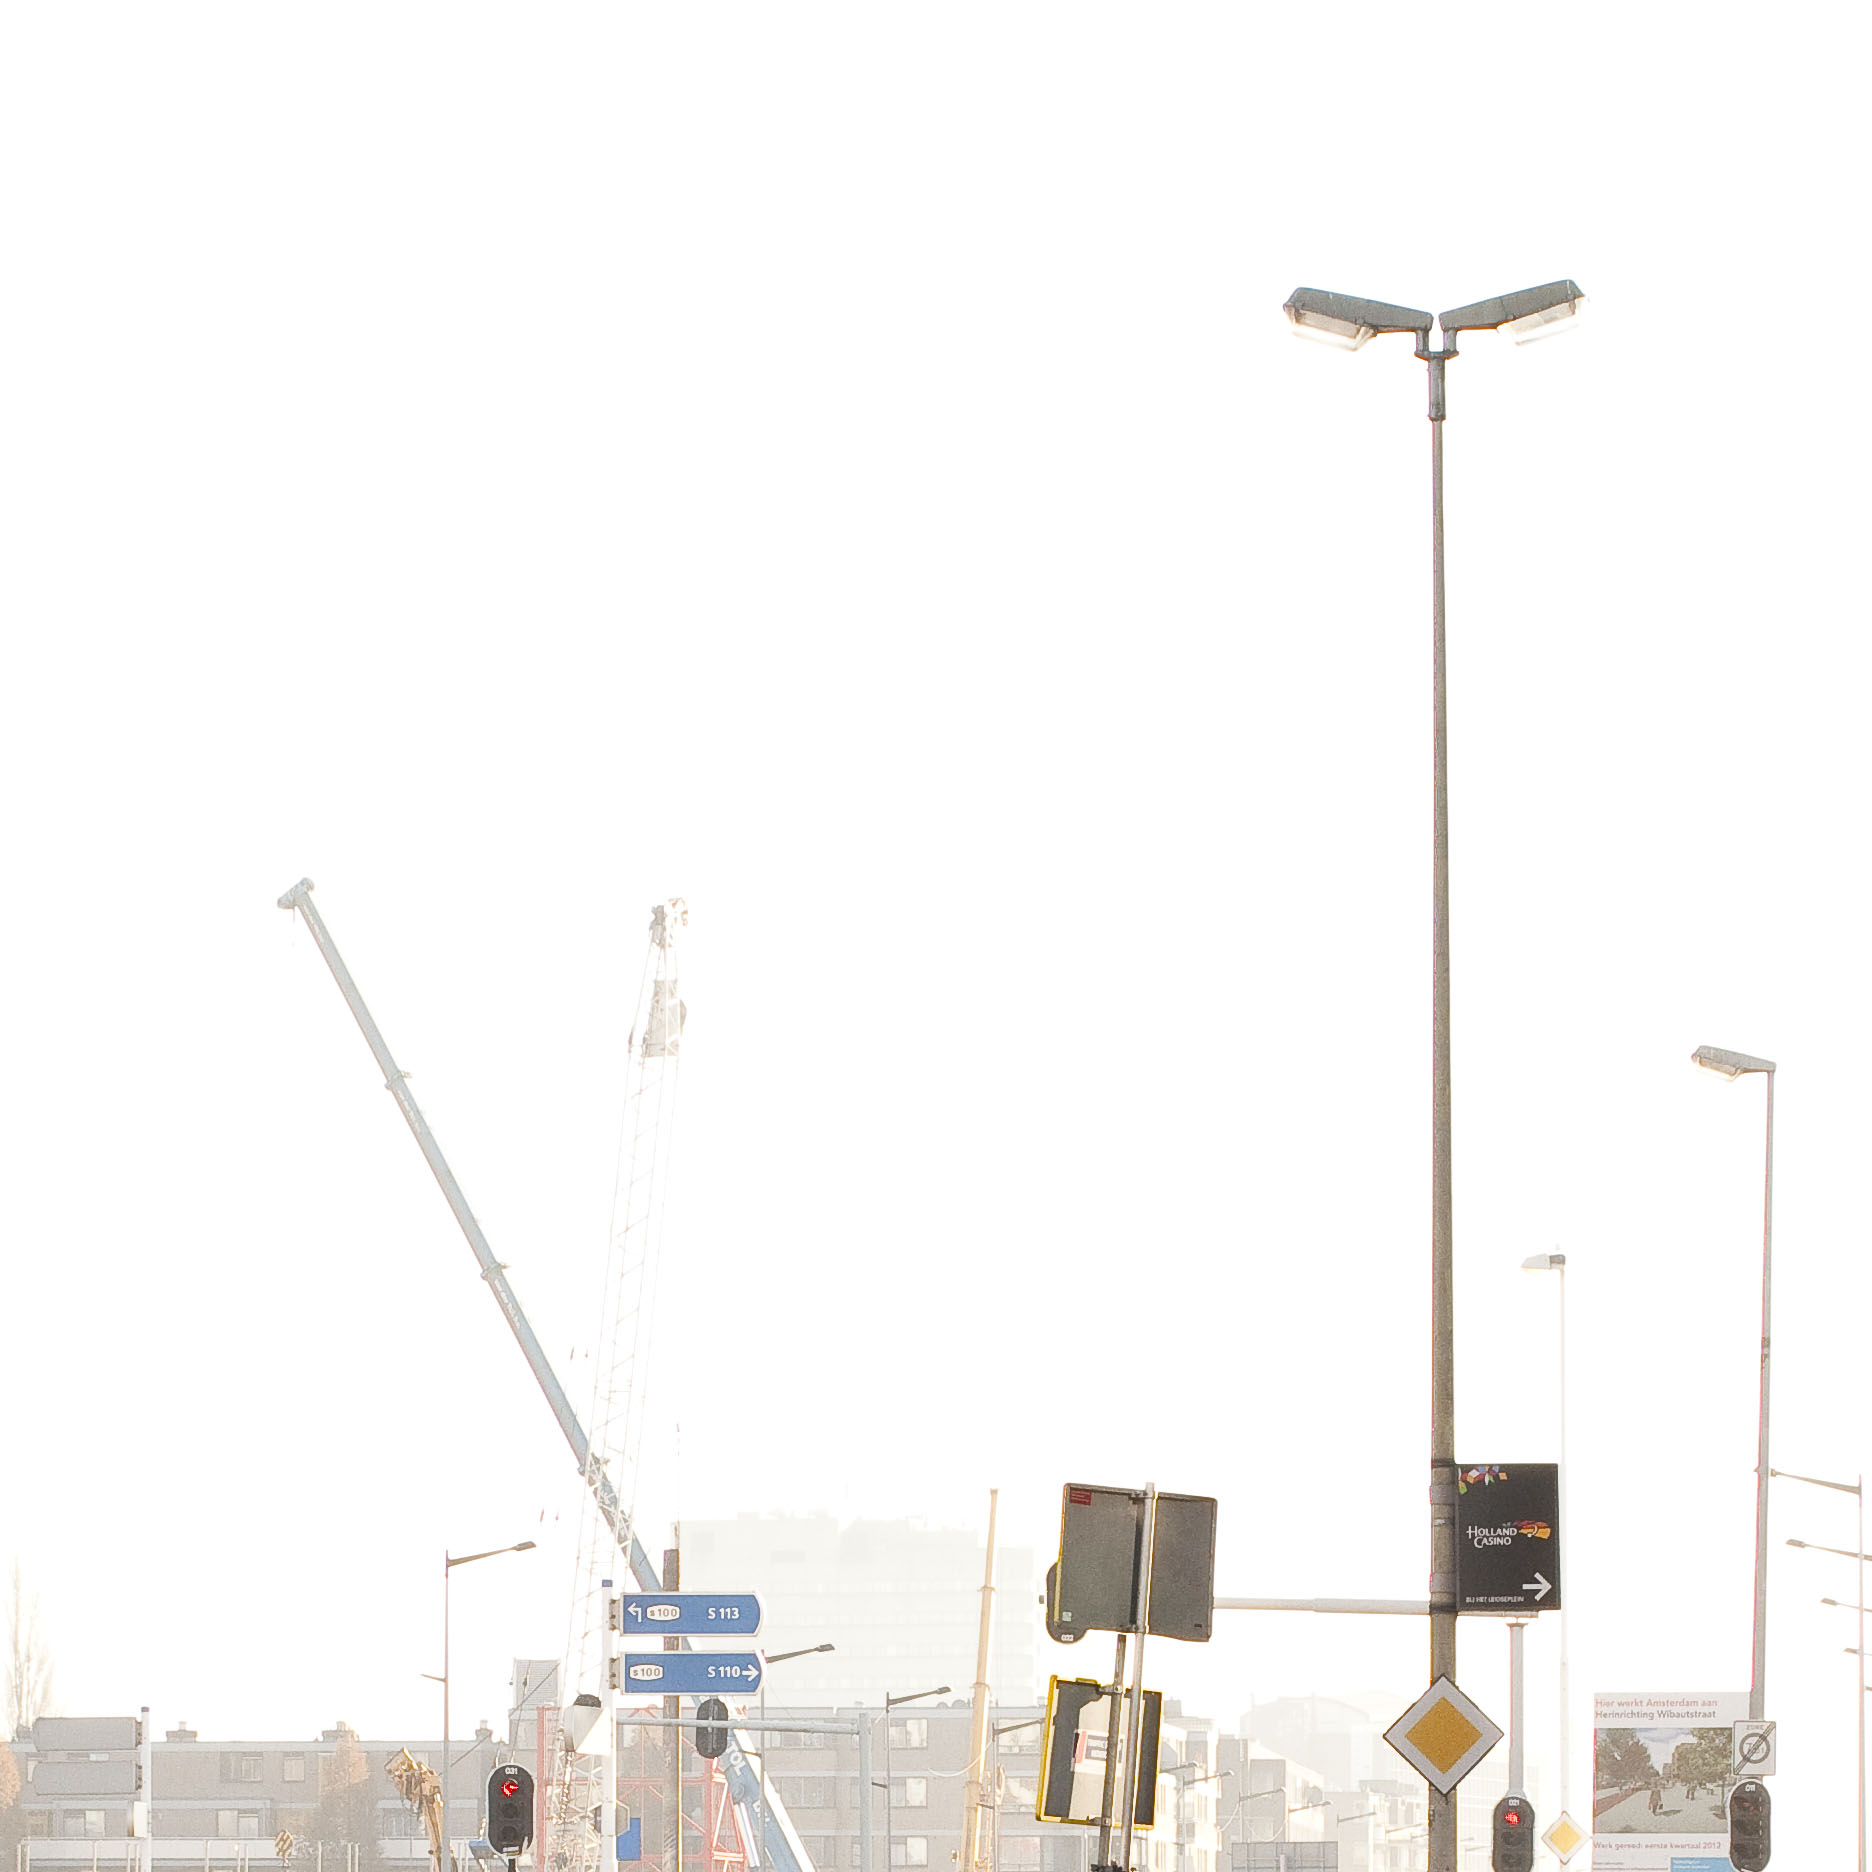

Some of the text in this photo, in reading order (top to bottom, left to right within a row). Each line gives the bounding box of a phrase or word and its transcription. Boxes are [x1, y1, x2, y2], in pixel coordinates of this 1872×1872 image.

[1646, 1699, 1699, 1707] Amsterdam
[1595, 1710, 1716, 1720] Herinrichting Wibautstraat
